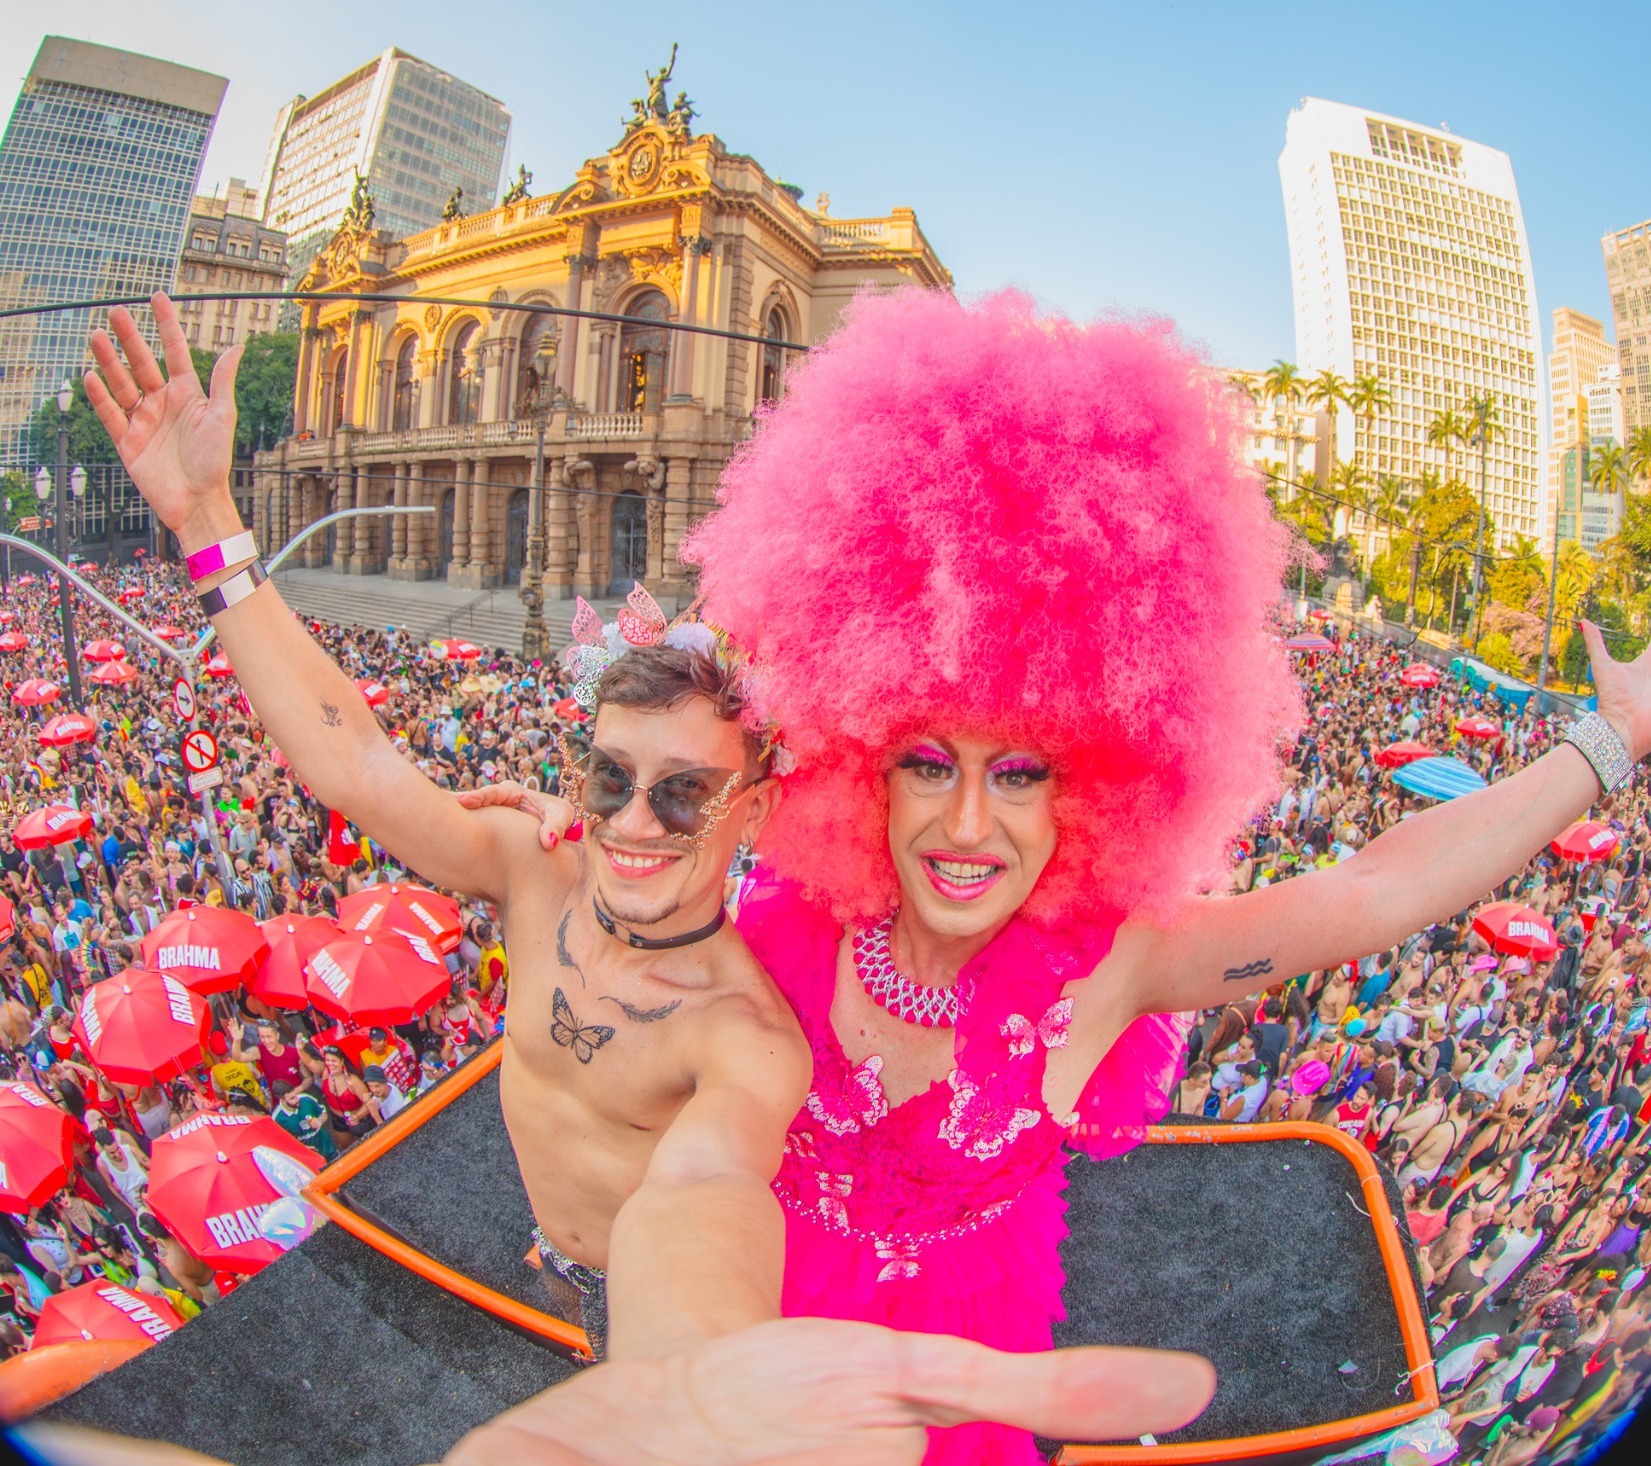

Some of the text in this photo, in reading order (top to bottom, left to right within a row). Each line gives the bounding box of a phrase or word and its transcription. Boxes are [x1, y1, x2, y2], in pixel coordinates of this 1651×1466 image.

[1508, 921, 1550, 945] BRAHMA
[158, 944, 221, 971] BRAHMA
[170, 1113, 252, 1140] BRAHMA
[205, 1203, 270, 1249] BRAH
